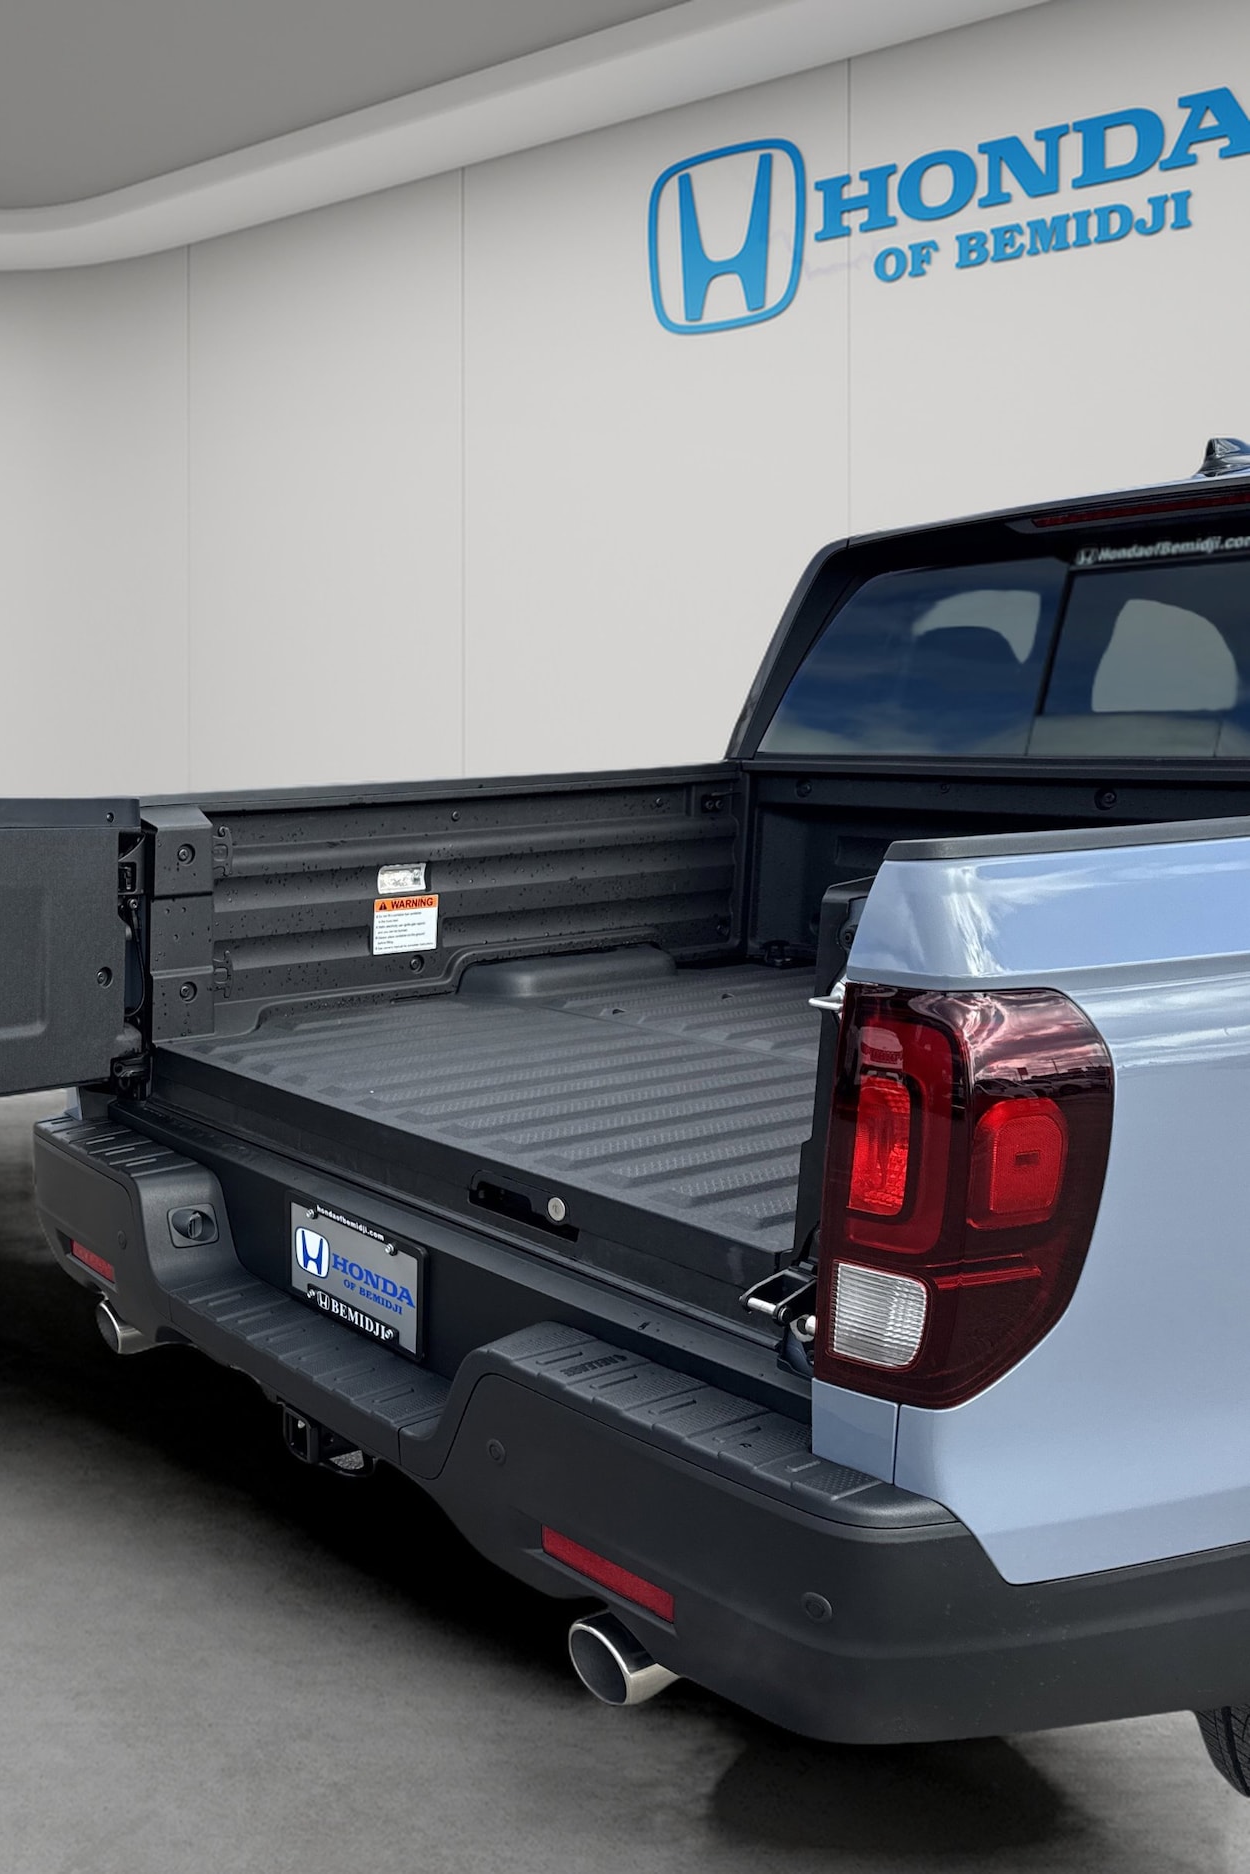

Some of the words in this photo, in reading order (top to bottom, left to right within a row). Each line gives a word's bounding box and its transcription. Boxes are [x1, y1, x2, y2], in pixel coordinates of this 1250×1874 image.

[814, 86, 1250, 242] HONDA
[874, 240, 940, 282] OF
[955, 190, 1193, 269] BEMIDJI
[391, 897, 433, 909] WARNING
[317, 1205, 384, 1241] hondaofbemidji.com
[332, 1253, 416, 1309] HONDA
[343, 1279, 357, 1291] OF
[359, 1287, 403, 1315] BEMIDJI
[331, 1298, 386, 1340] BEMIDJI
